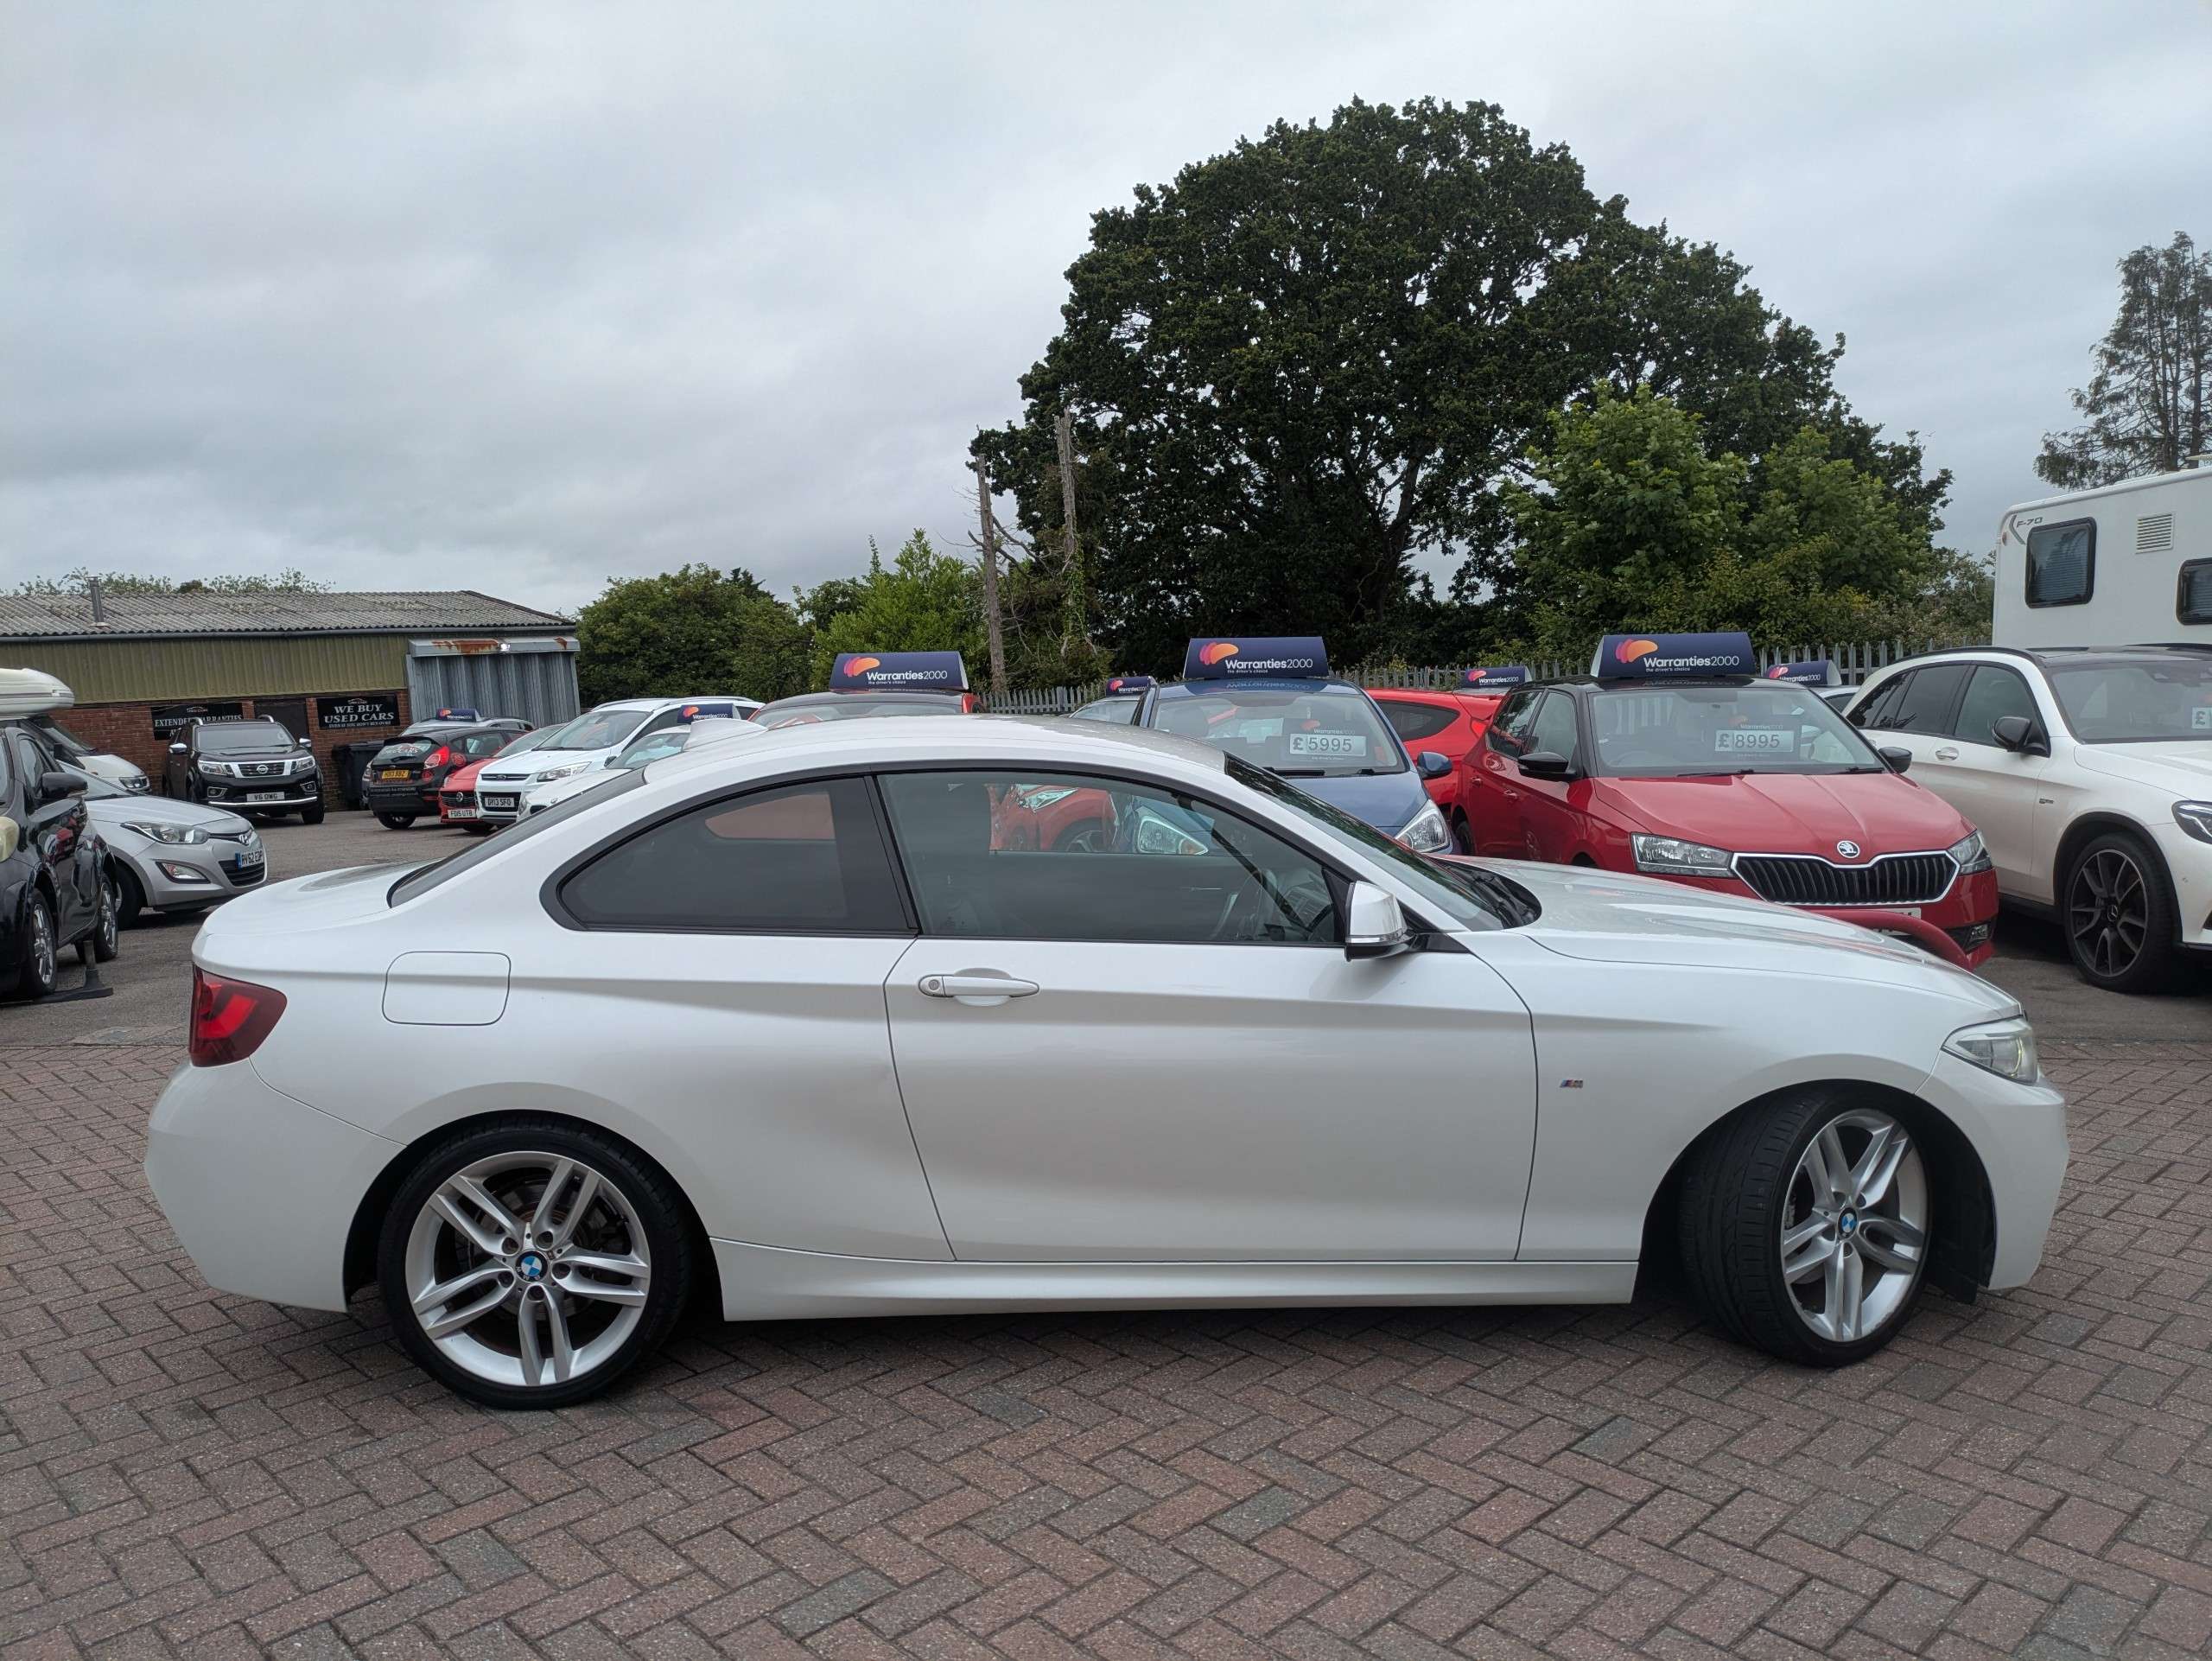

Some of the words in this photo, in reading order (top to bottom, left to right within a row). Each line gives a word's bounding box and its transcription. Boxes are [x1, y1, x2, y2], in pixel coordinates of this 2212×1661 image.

[2017, 517, 2043, 527] F-70
[1225, 659, 1313, 670] Warranties2000
[1643, 655, 1739, 668] Warranties2000
[867, 670, 948, 681] Warranties2000
[334, 705, 354, 714] WE
[358, 704, 383, 713] BUY
[156, 717, 191, 727] EXTENDE
[324, 714, 359, 723] USED
[361, 712, 394, 722] CARS
